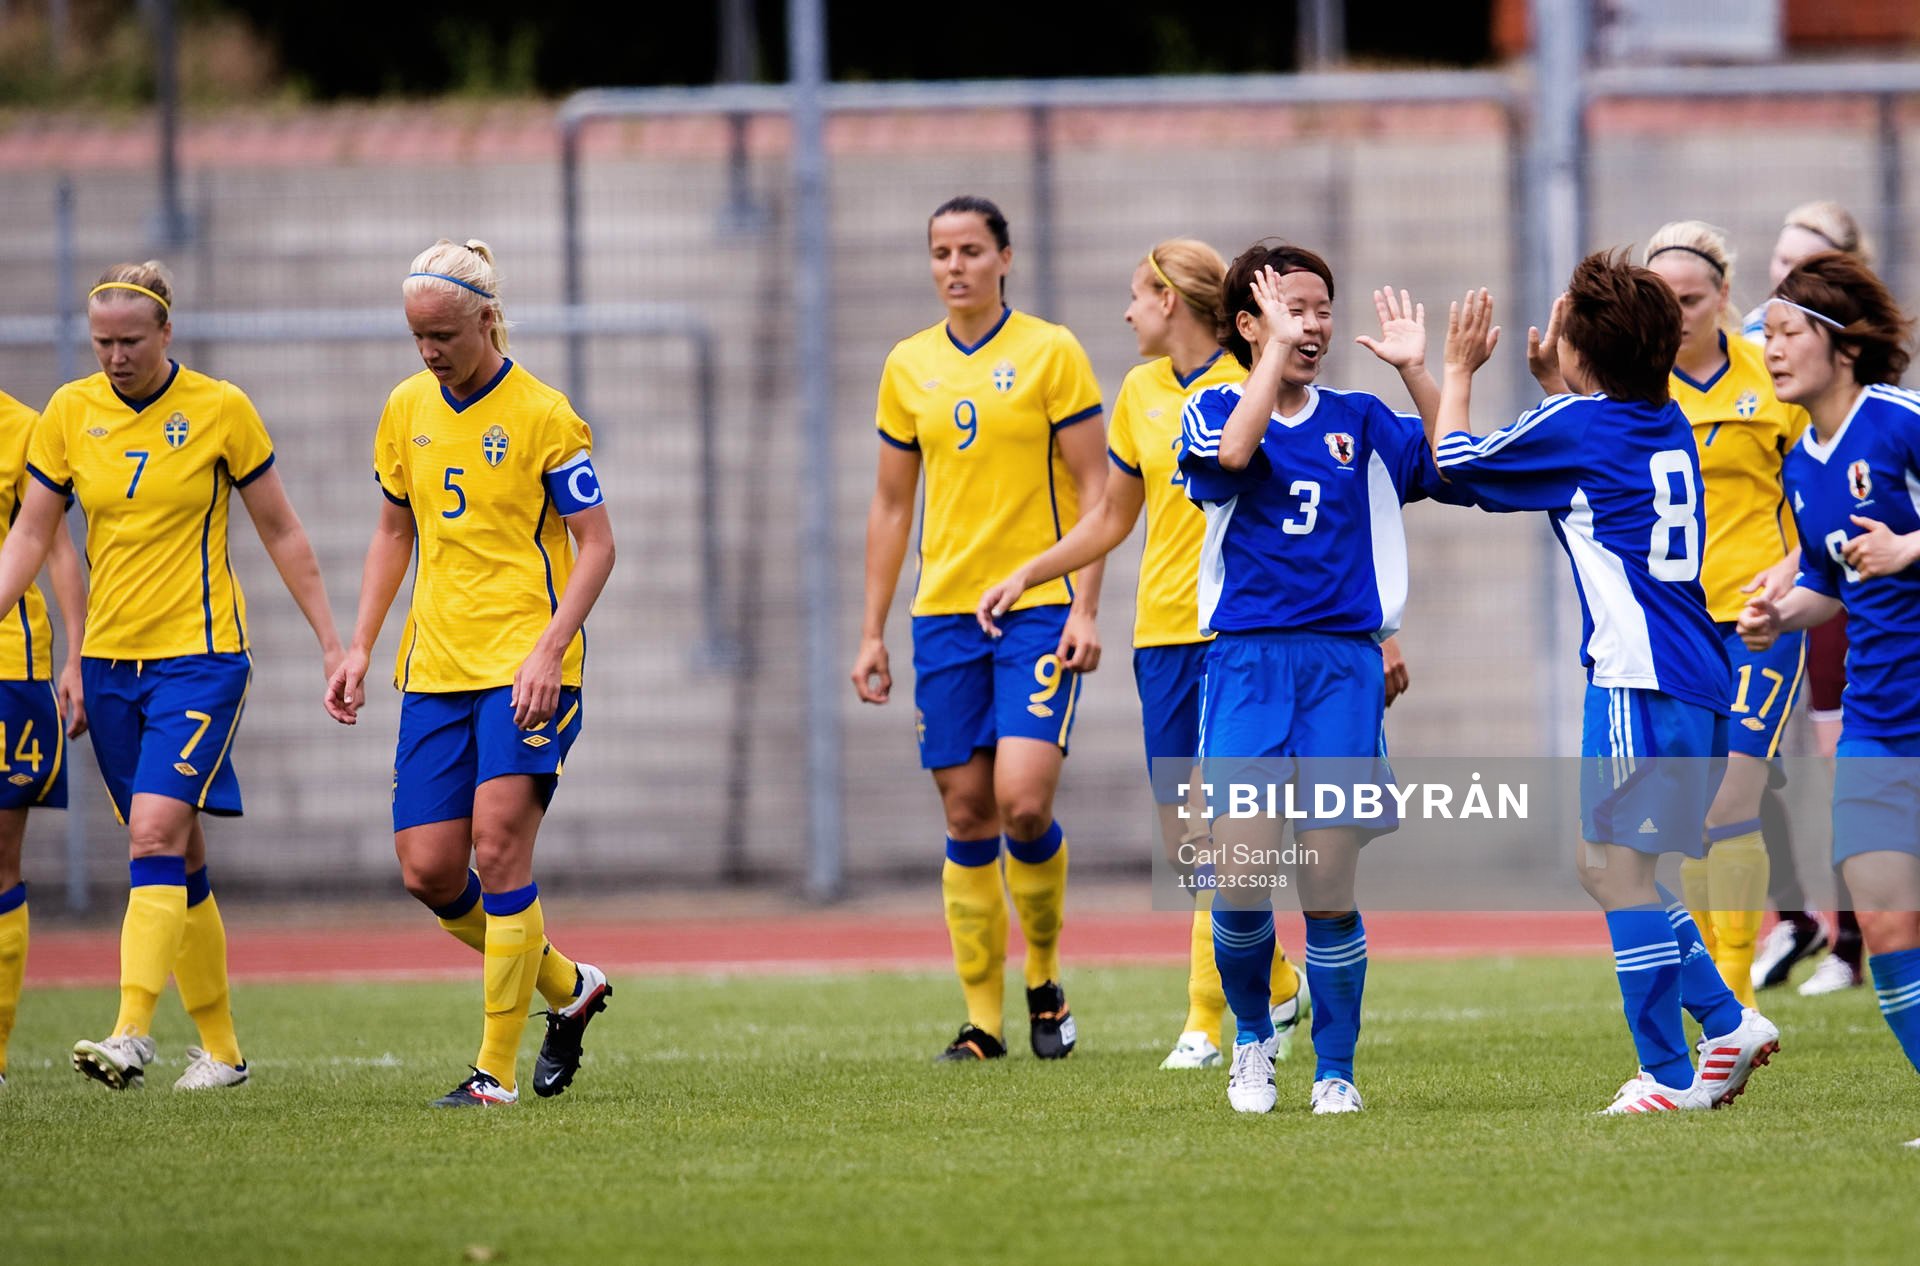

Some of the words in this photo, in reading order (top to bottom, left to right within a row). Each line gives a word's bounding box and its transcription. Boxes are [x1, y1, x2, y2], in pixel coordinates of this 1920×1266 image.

[953, 399, 978, 450] 9
[124, 451, 149, 499] 7
[441, 467, 467, 519] 5
[567, 466, 600, 504] C
[1282, 480, 1321, 535] 3
[1647, 449, 1699, 582] 8
[1029, 653, 1063, 704] 9
[1731, 664, 1784, 720] 17
[0, 719, 44, 773] 14
[180, 710, 212, 761] 7
